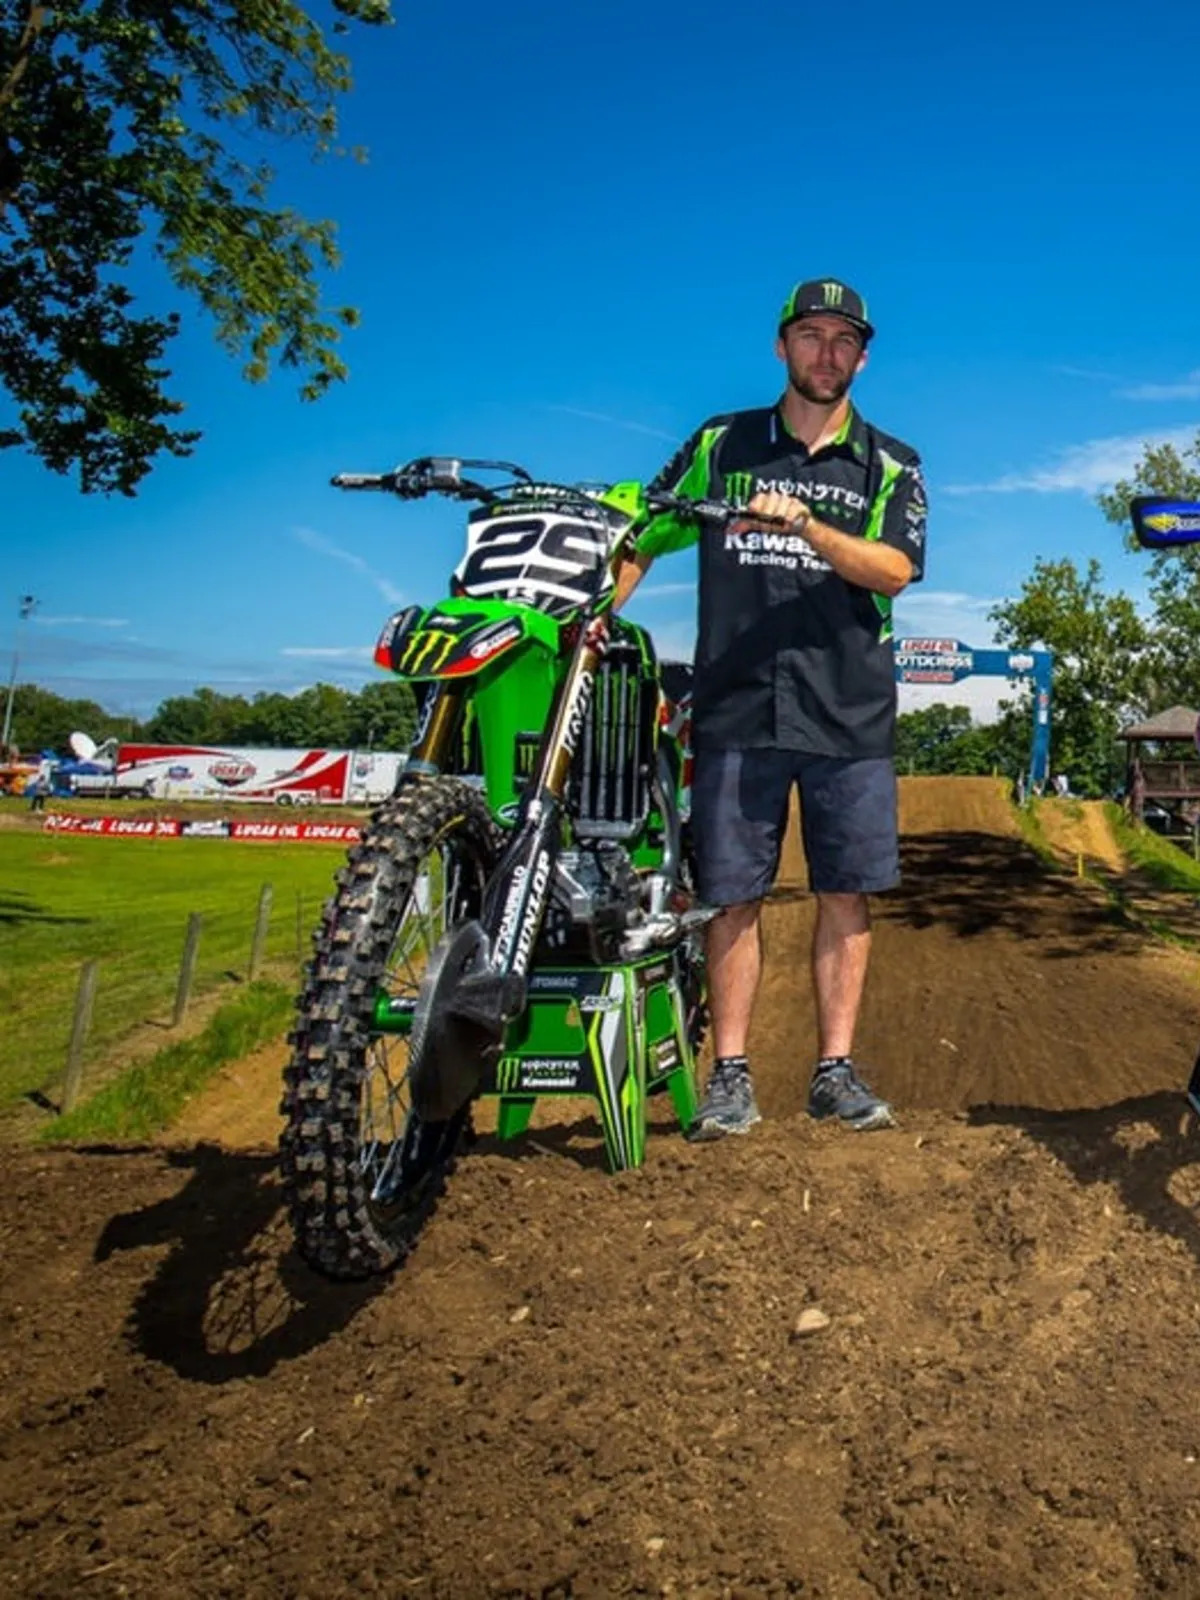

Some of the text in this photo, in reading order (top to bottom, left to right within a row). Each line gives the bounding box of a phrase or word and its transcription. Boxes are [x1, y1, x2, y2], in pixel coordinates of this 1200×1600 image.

[724, 532, 817, 556] Kawa
[739, 552, 833, 571] Racing Tea
[109, 819, 154, 834] LUCAS
[234, 823, 278, 837] LUCAS
[304, 825, 345, 838] LUCAS
[511, 851, 550, 977] DUNLOP
[521, 1060, 580, 1071] MONSTER
[521, 1077, 577, 1088] Kawasaki
